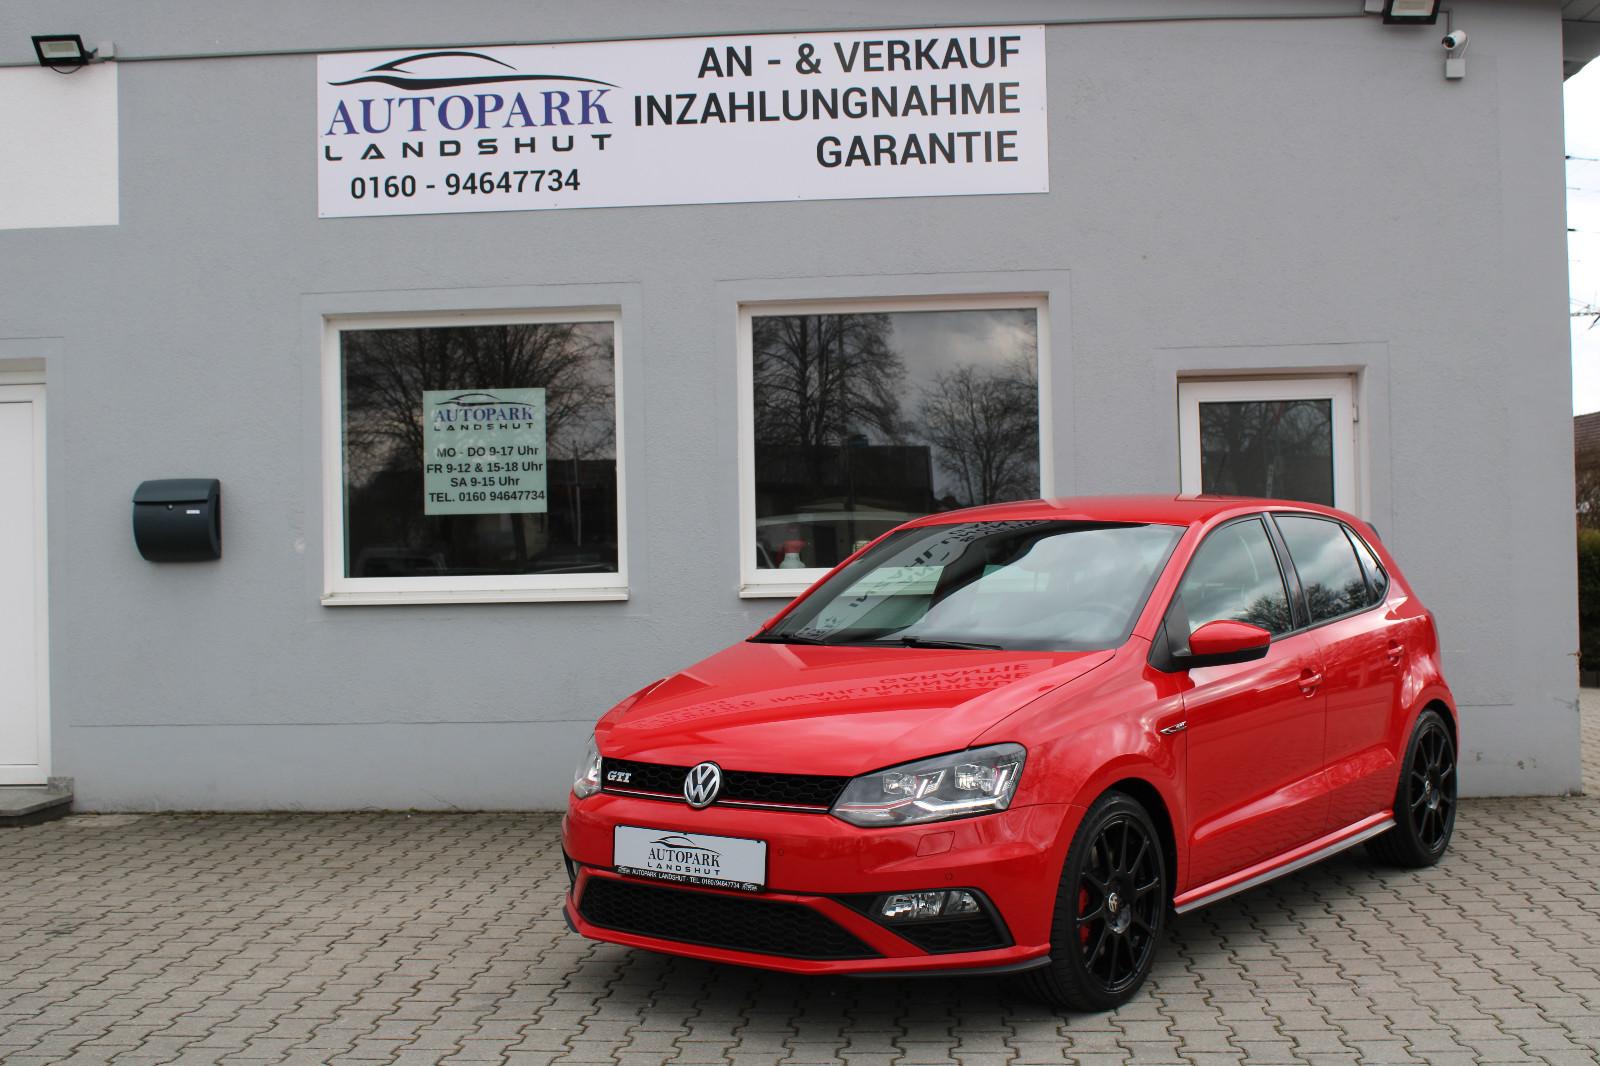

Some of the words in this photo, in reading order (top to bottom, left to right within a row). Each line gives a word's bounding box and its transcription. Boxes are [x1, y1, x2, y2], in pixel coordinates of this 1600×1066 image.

[697, 45, 753, 79] AN
[795, 43, 822, 75] &
[833, 35, 1021, 73] VERKAUF
[634, 81, 1021, 127] INZAHLUNGNAHME
[324, 89, 613, 136] AUTOPARK
[324, 133, 612, 161] LANDSHUT
[816, 130, 1019, 168] GARANTIE
[350, 174, 416, 200] 0160
[445, 168, 581, 196] 94647734
[435, 407, 533, 422] AUTOPARK
[433, 423, 534, 431] LANDSHUT
[436, 447, 456, 458] MO
[467, 446, 486, 457] DO
[489, 446, 514, 456] 9-17
[517, 445, 539, 456] Uhr
[426, 463, 443, 474] FR
[446, 463, 471, 474] 9-12
[474, 462, 484, 473] &
[487, 462, 518, 472] 15-18
[521, 461, 543, 472] Uhr
[450, 477, 467, 487] SA
[470, 476, 495, 487] 9-15
[498, 475, 520, 486] Uhr
[429, 492, 455, 502] TEL.
[458, 491, 486, 502] 0160
[489, 490, 545, 501] 94647734
[607, 770, 632, 783] GTI
[648, 847, 720, 867] AUTOPARK
[647, 861, 721, 876] LANDSHUT
